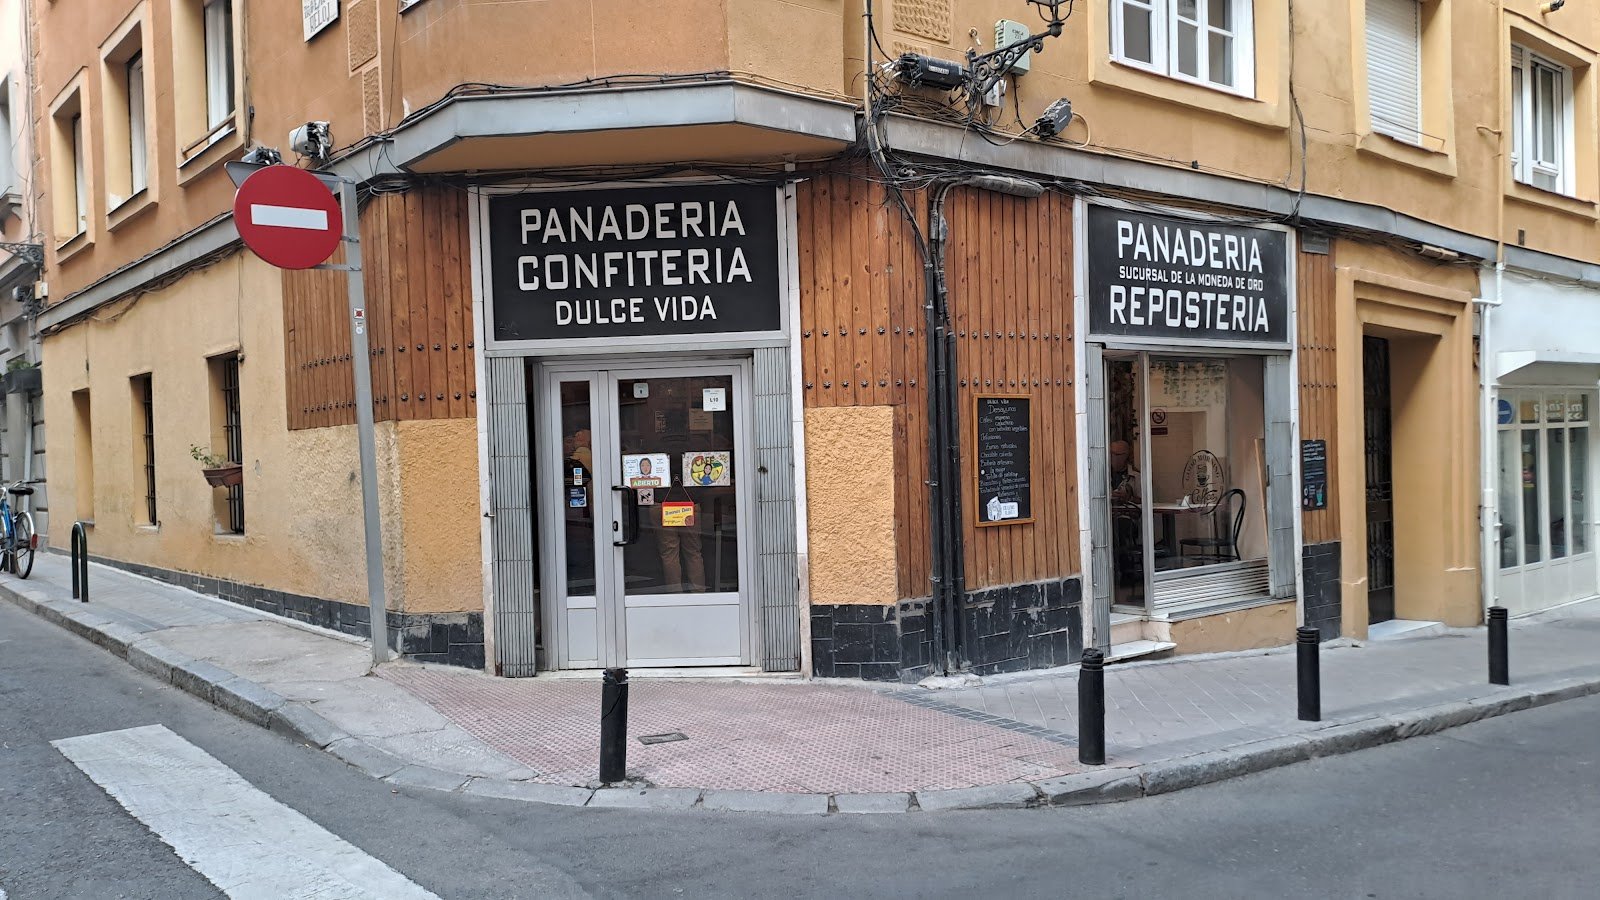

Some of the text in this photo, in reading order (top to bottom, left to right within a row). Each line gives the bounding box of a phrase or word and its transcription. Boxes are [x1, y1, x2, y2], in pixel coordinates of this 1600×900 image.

[520, 200, 746, 245] PANADERIA
[517, 246, 753, 291] CONFITERIA
[1117, 220, 1264, 274] PANADERIA
[1119, 265, 1264, 292] SUCURSAL DE LA MONEDA DE ORO
[555, 295, 718, 326] DULCE VIDA
[1109, 285, 1270, 333] REPOSTERIA
[632, 479, 660, 487] ABIERTO
